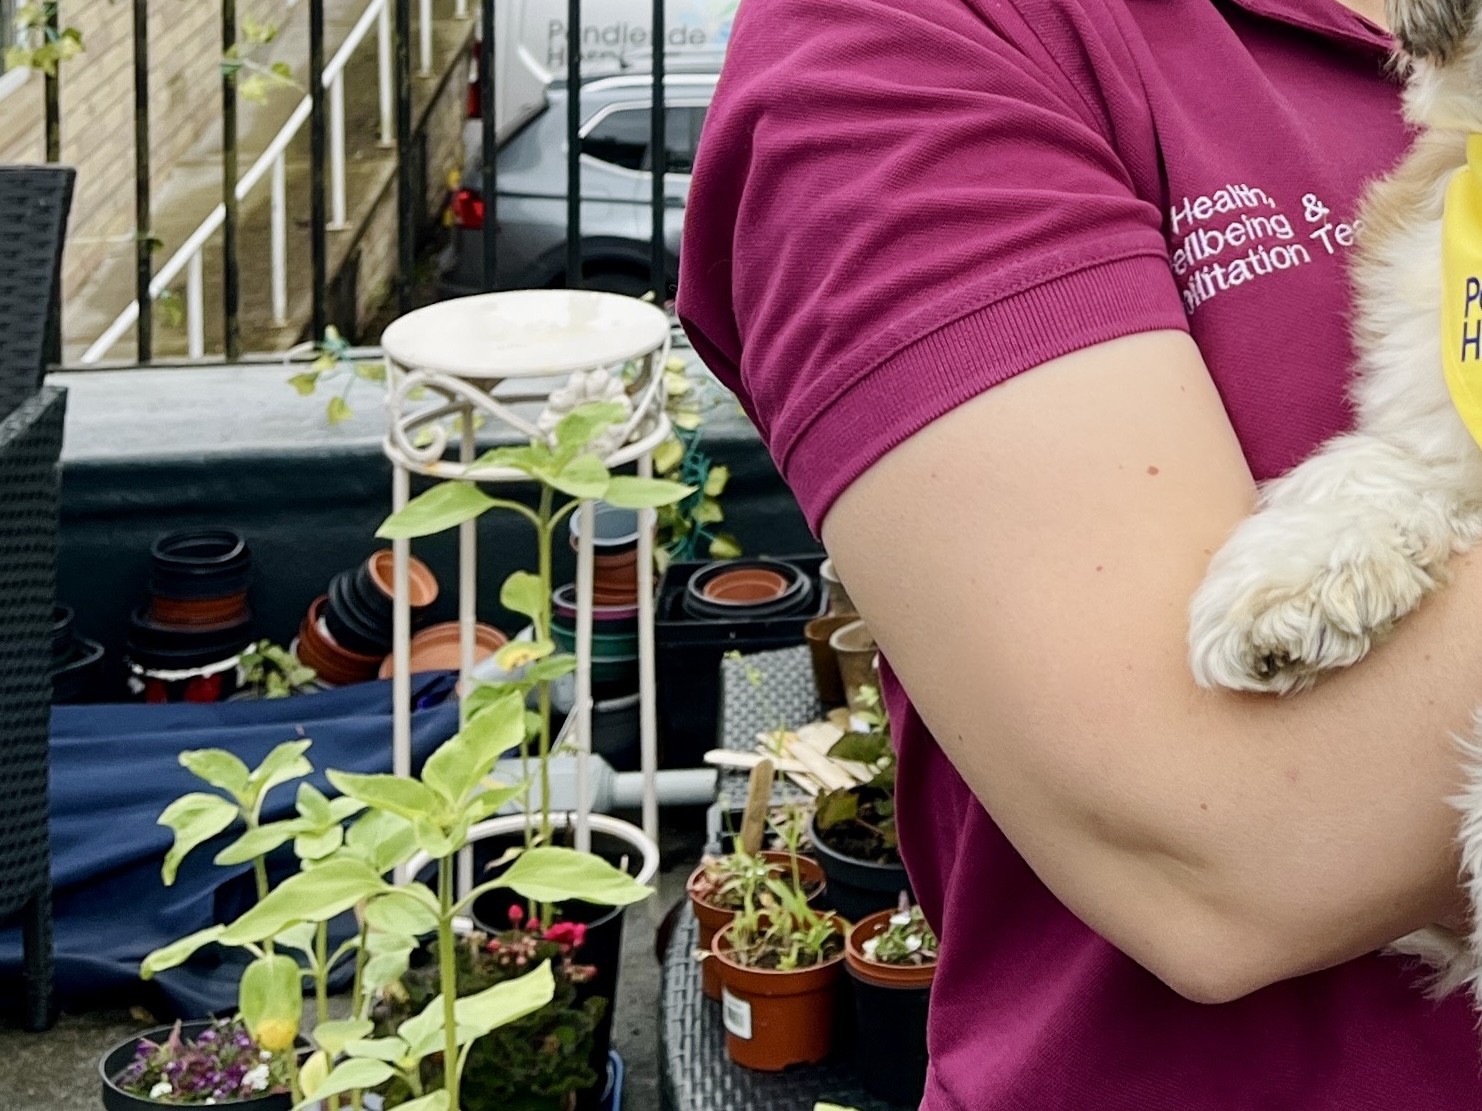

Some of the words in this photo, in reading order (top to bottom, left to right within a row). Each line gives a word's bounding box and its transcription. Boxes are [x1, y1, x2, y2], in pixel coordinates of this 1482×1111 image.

[547, 19, 706, 46] Pndlede
[1170, 183, 1276, 234] Health,
[1172, 214, 1295, 275] ellbeing
[1301, 193, 1331, 223] &
